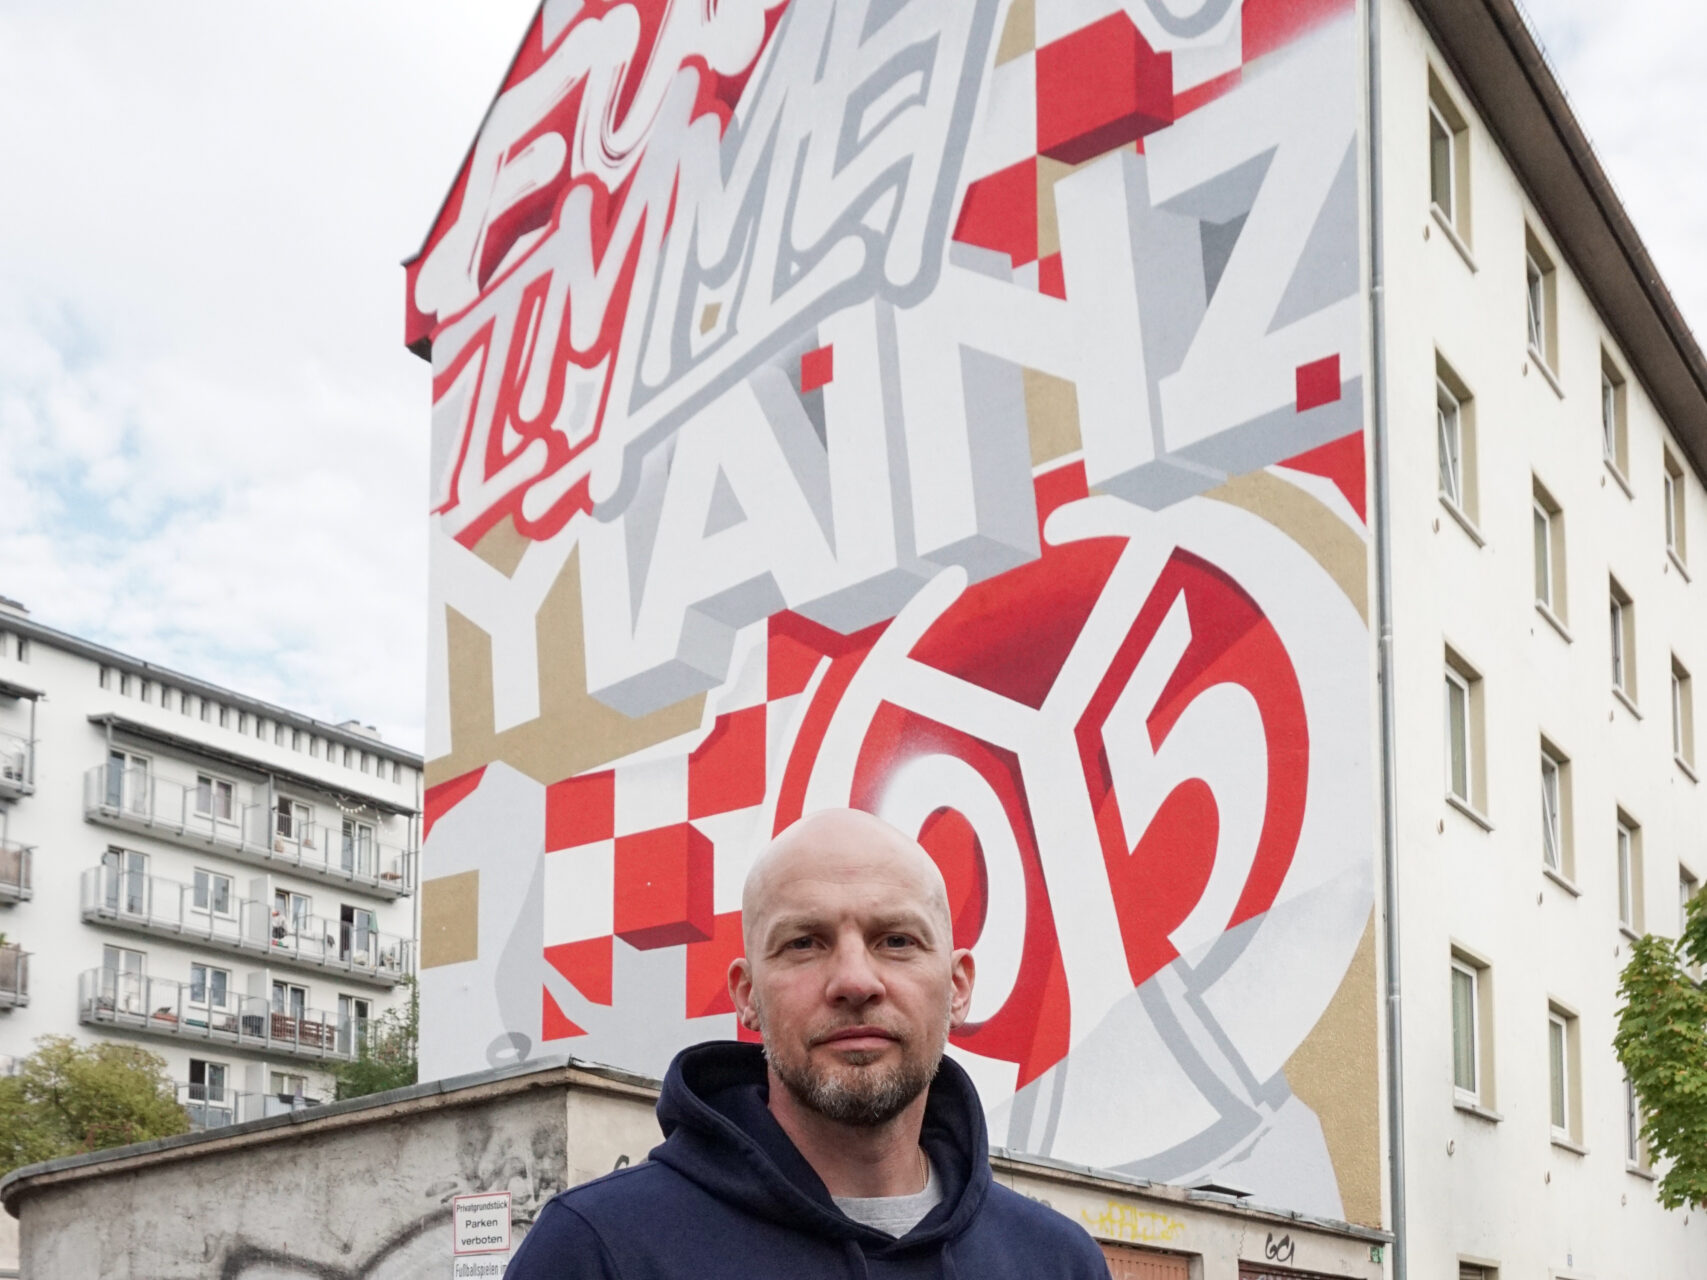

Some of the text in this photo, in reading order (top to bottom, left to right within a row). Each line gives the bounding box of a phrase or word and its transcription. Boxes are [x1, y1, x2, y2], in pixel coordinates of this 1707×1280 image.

[456, 1200, 508, 1213] Privatgrundstück
[465, 1218, 498, 1229] Parken
[461, 1235, 503, 1246] verboten
[456, 1262, 499, 1279] Fußballspielen
